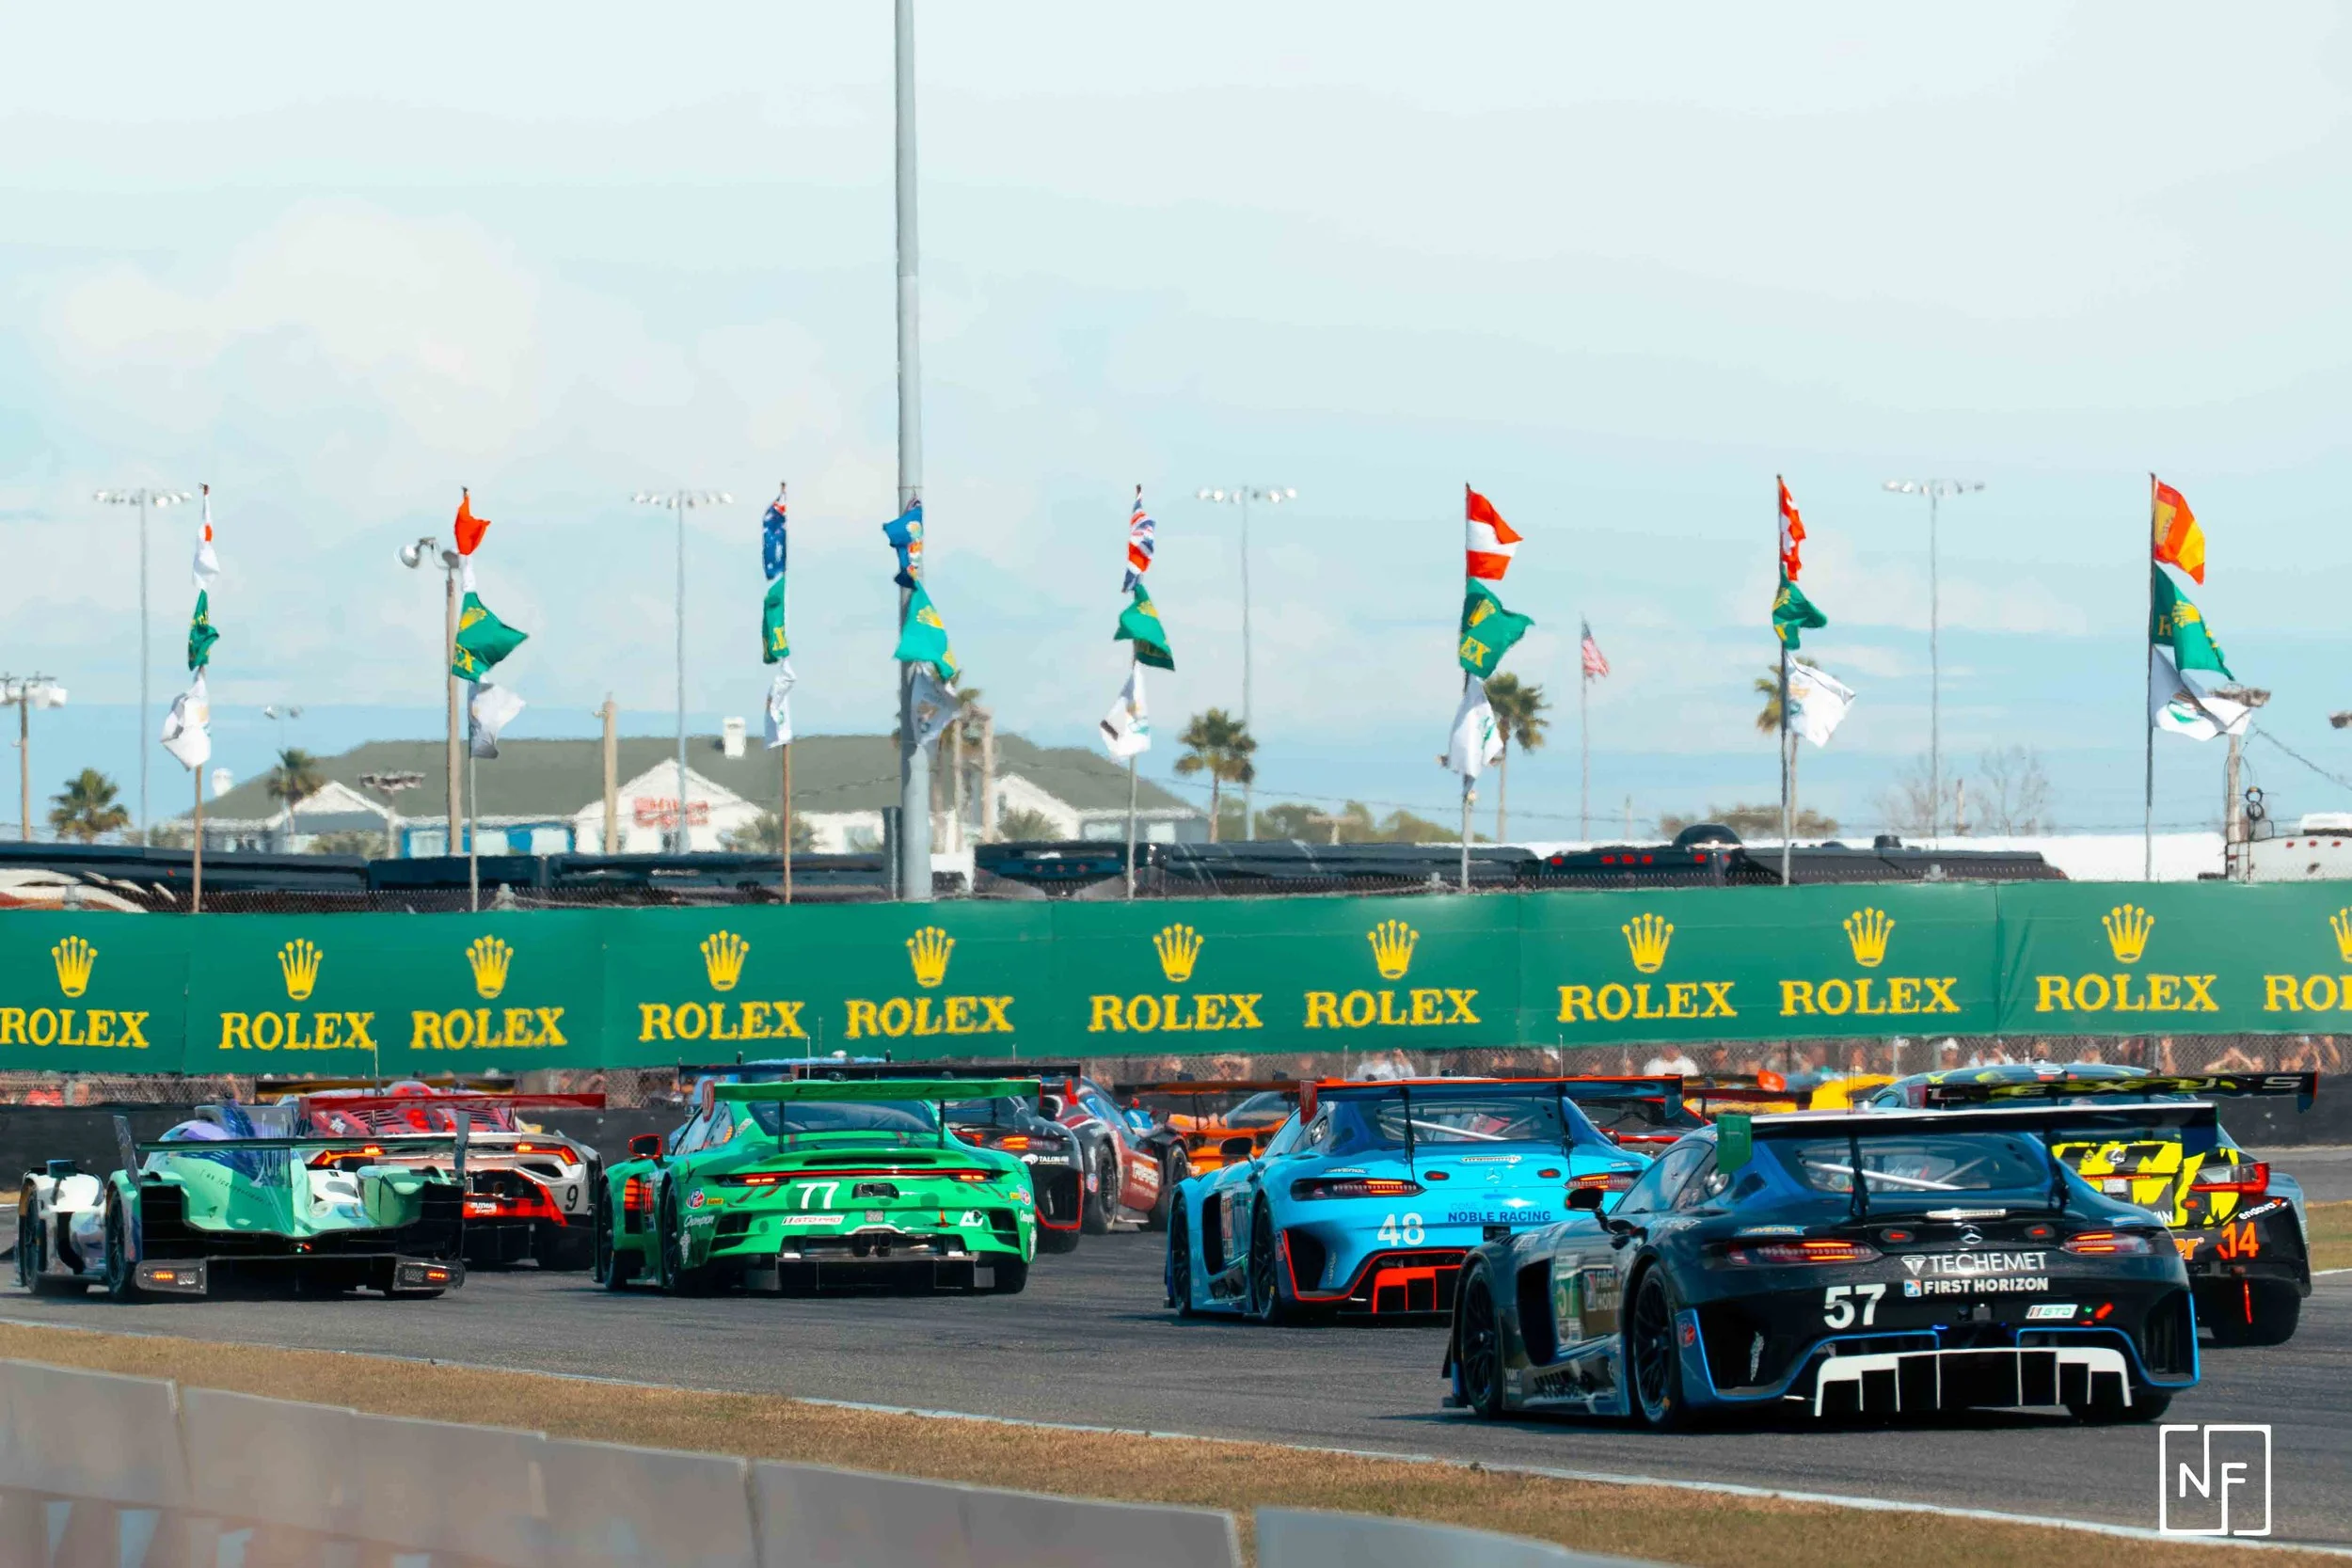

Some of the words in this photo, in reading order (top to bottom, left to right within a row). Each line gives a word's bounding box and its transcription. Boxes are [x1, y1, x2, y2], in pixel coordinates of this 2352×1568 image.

[1303, 988, 1482, 1028] ROLEX
[1556, 980, 1738, 1022] ROLEX
[1778, 975, 1961, 1017] ROLEX
[2034, 972, 2219, 1012] ROLEX
[0, 1006, 151, 1049] ROLEX
[217, 1010, 376, 1051] ROLEX
[409, 1006, 568, 1050] ROLEX
[638, 1000, 807, 1042] ROLEX
[844, 994, 1015, 1038] ROLEX
[1087, 992, 1263, 1033] ROLEX
[564, 1184, 579, 1212] 9
[796, 1181, 840, 1211] 77
[2238, 1202, 2278, 1220] endava
[1376, 1212, 1425, 1247] 48
[1447, 1211, 1495, 1223] NOBLE
[1499, 1210, 1551, 1222] RACING
[2221, 1221, 2260, 1259] 14
[1928, 1252, 2047, 1274] TECHEMET
[1923, 1280, 1971, 1295] FIRST
[1975, 1276, 2049, 1293] HORIZON
[1823, 1282, 1887, 1330] 57
